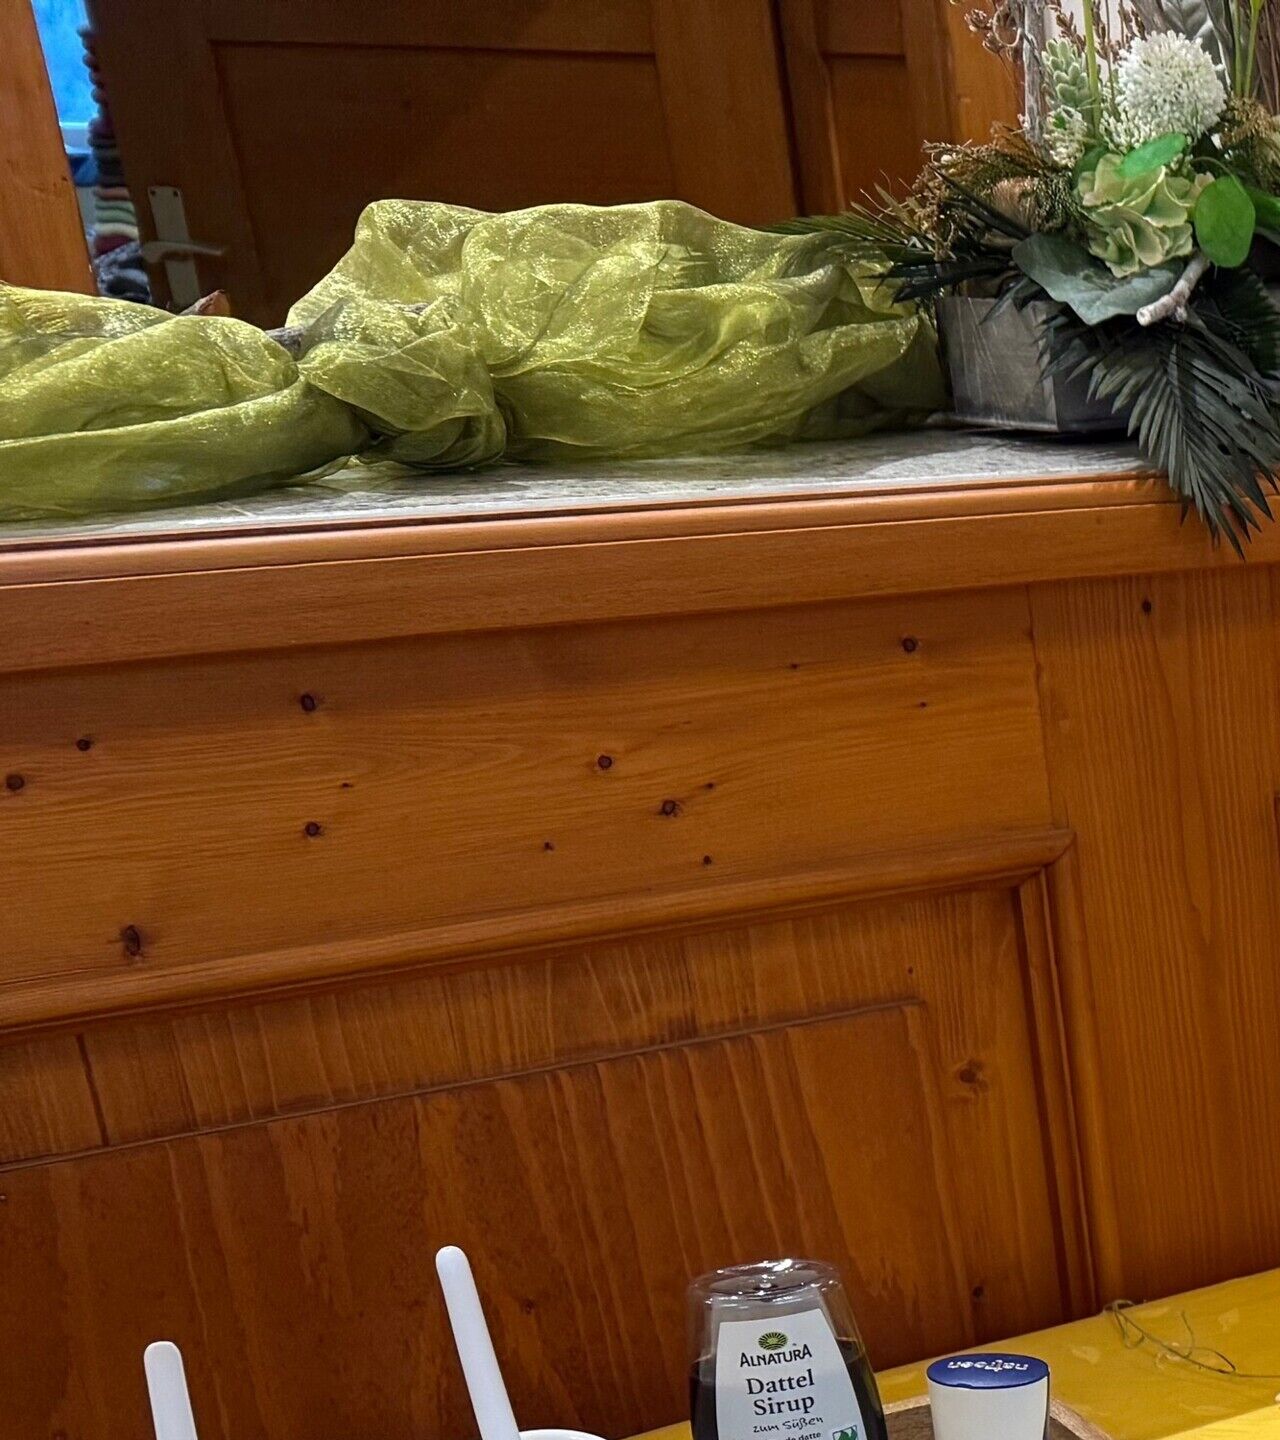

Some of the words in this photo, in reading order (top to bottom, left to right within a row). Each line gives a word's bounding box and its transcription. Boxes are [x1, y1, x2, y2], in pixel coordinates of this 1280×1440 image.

[739, 1344, 813, 1368] ALNATURA
[746, 1368, 815, 1395] Dattel
[754, 1395, 815, 1416] Sirup
[753, 1424, 780, 1434] zum
[782, 1416, 824, 1432] Süßen
